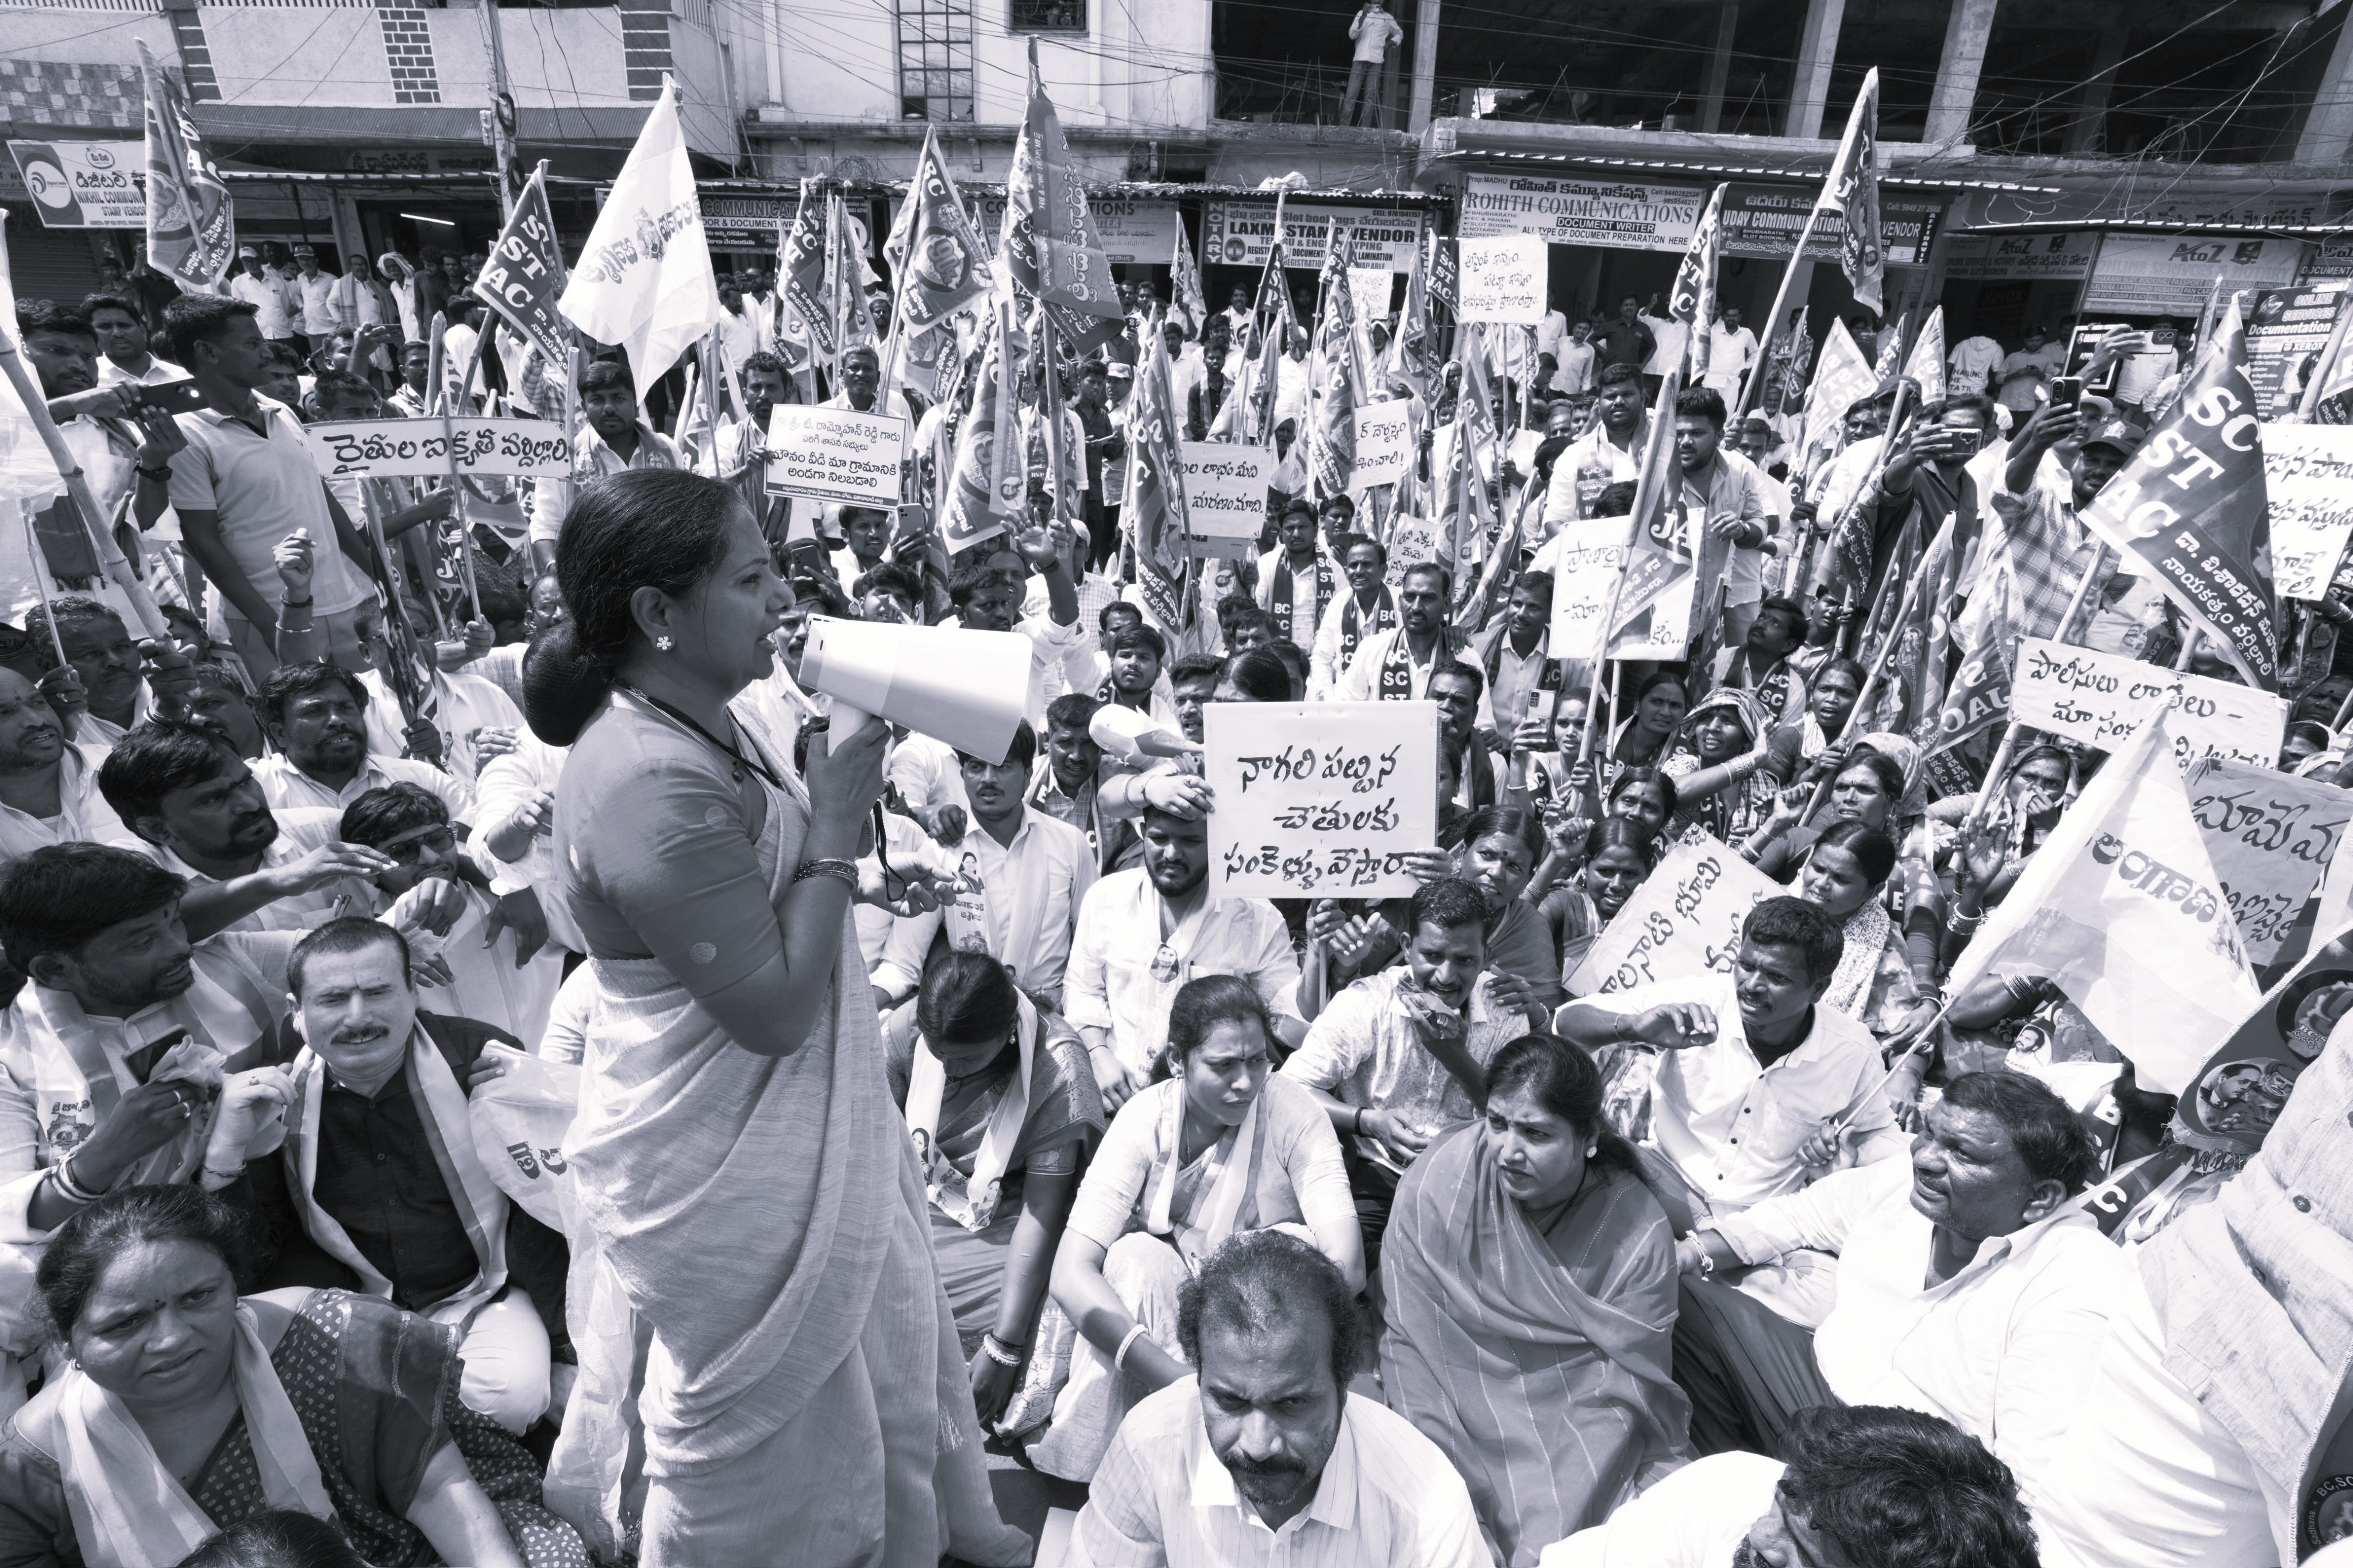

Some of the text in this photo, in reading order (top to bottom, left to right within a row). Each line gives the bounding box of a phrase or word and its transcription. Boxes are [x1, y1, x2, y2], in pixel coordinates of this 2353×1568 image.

[923, 158, 946, 197] BC
[1468, 175, 1507, 185] Prop:MADHU
[1510, 179, 1557, 192] రోహిత్
[76, 191, 104, 203] NIKHIL
[1663, 198, 1699, 207] 9959546217
[1745, 195, 1787, 208] ఉదయ్
[102, 206, 121, 217] STAMP
[1283, 212, 1304, 222] Slot
[1468, 193, 1694, 224] ROHITH COMMUNICATIONS
[1887, 203, 1941, 213] Cell: 9949 27 2688
[722, 219, 777, 229] & DOCUMENT
[1229, 222, 1275, 236] LAXM
[1351, 227, 1415, 243] VENDOR
[1557, 218, 1655, 234] DOCUMENT WRITER
[1723, 210, 1748, 226] UDAY
[1883, 221, 1922, 238] VENDOR
[792, 219, 818, 250] SC
[1208, 203, 1224, 264] NOTARY
[1522, 226, 1689, 246] ALL TYPE OF DOCUMENT PREPARATION HERE
[1918, 213, 1936, 263] AFFIDAVIT
[1297, 239, 1303, 248] &
[500, 235, 547, 280] ST
[1330, 254, 1345, 270] ST
[1359, 252, 1393, 261] LAMINATION
[1440, 254, 1456, 272] SC
[1436, 266, 1454, 284] ST
[2140, 277, 2167, 285] BOOKING
[2294, 292, 2336, 307] ONLINE
[534, 307, 547, 326] డా.
[1327, 302, 1343, 333] BC
[2282, 307, 2337, 322] SERVICES
[2248, 321, 2332, 335] Documentation
[2293, 342, 2325, 351] XEROX
[2189, 386, 2262, 452] SC
[802, 433, 869, 453] పరిగి శాసన సభ్యులు
[865, 426, 878, 444] రెడ్డి
[880, 431, 901, 443] గారు
[772, 448, 897, 476] మౌనం వీడి మా గ్రామానికి
[2138, 428, 2225, 491] ST
[788, 467, 878, 488] అండగా నిలబడాలి
[1202, 461, 1258, 482] లాభం మీది
[1192, 491, 1234, 511] మరణం
[1320, 571, 1336, 583] ST
[2175, 531, 2198, 558] డా.
[2201, 556, 2267, 619] విశారదన్
[2162, 556, 2235, 625] నాయకత్వం
[1274, 603, 1291, 615] BC
[1386, 649, 1407, 667] BC
[1383, 671, 1408, 686] SC
[2028, 650, 2119, 692] పోలీసులు
[1760, 690, 1784, 707] SC
[2052, 699, 2093, 723] మా
[1237, 744, 1317, 793] నాగలి
[1272, 797, 1400, 832] చేతులకు
[2086, 828, 2219, 923] లంగాణ
[2308, 1509, 2321, 1545] Sadhana,
